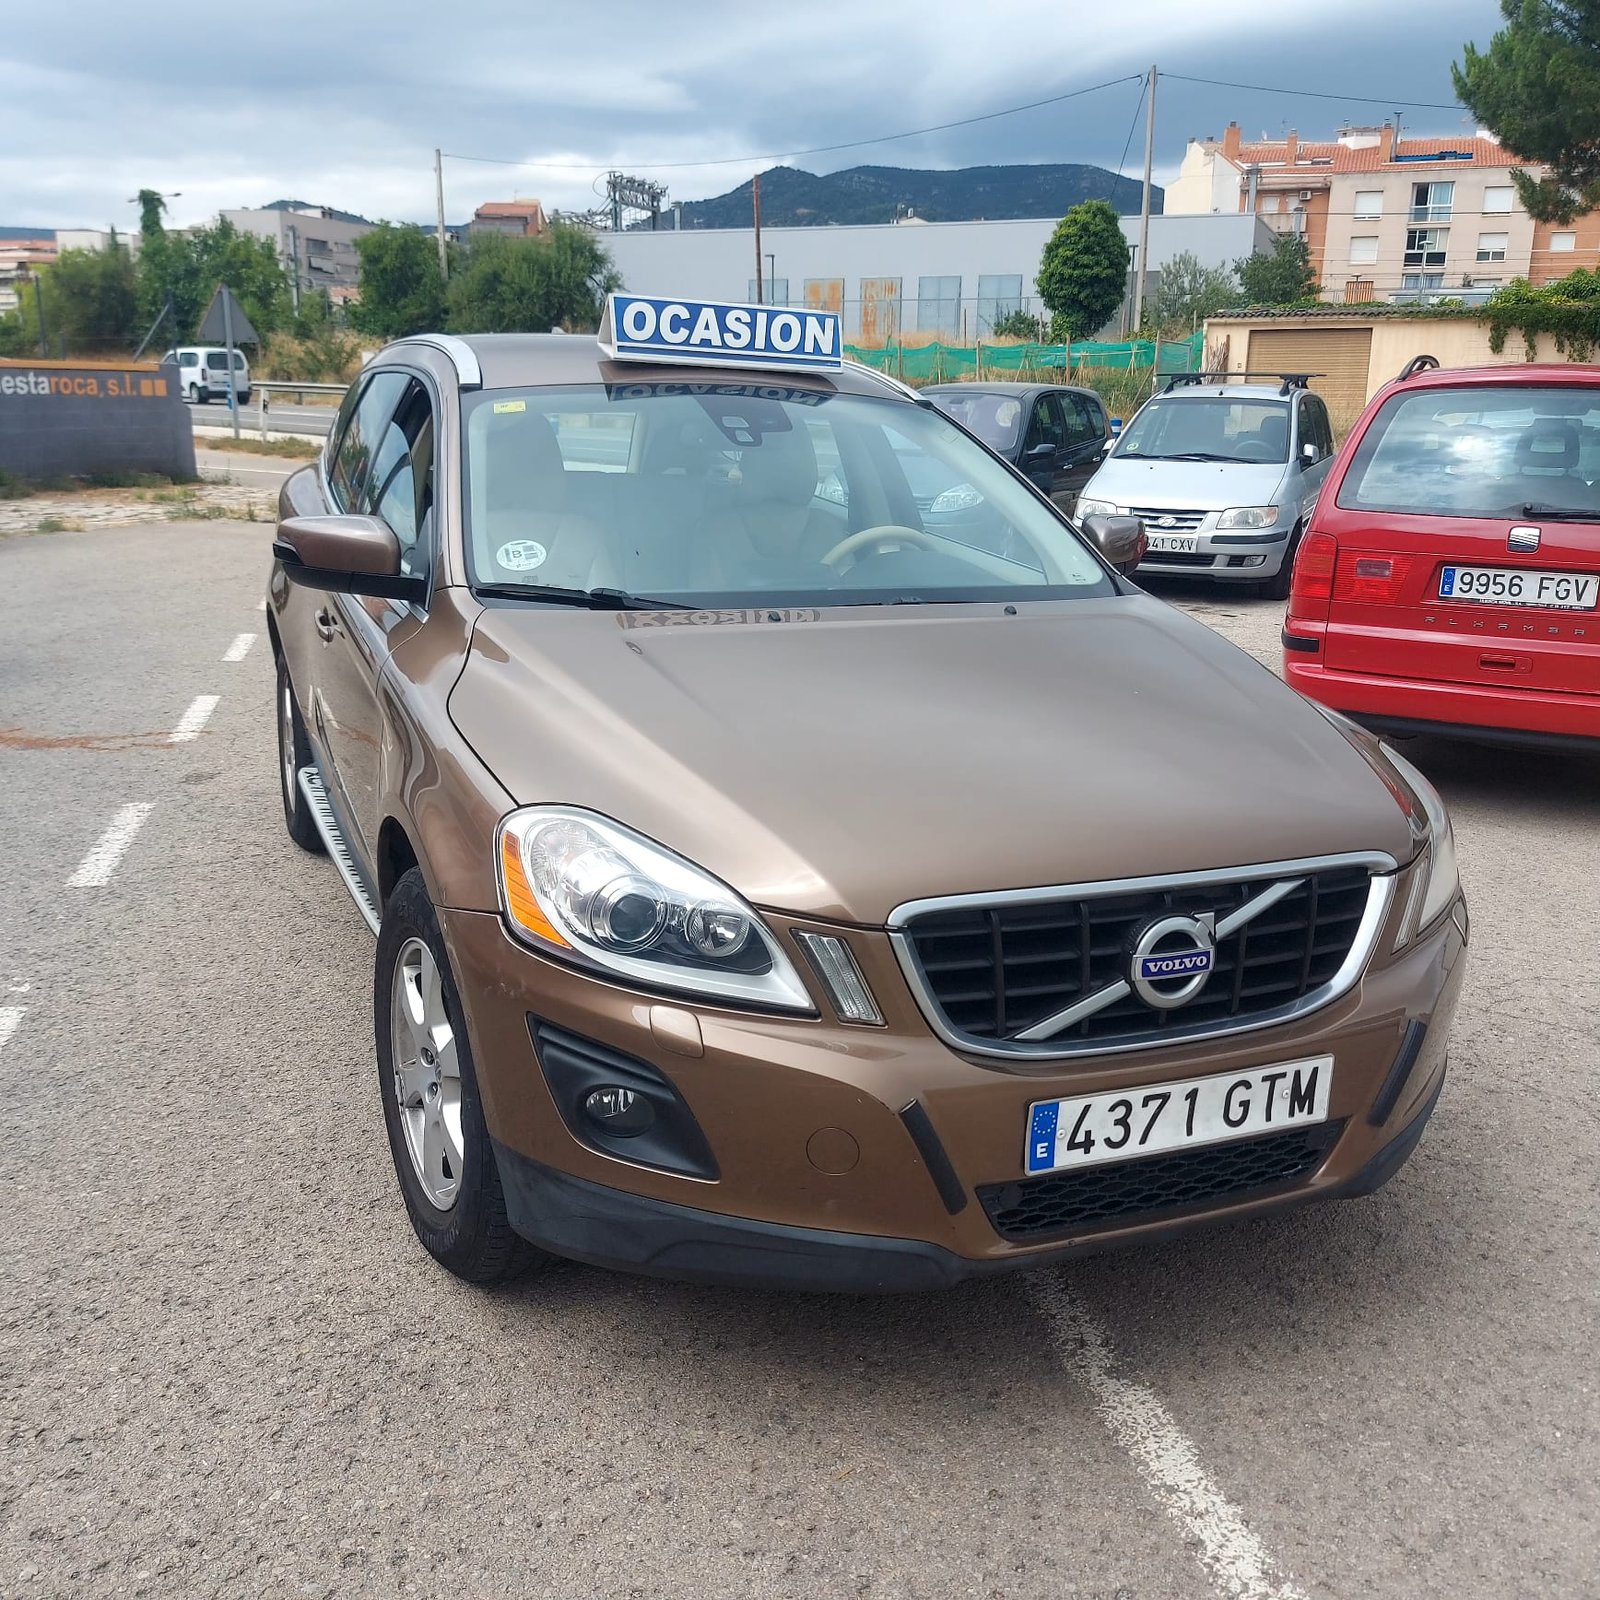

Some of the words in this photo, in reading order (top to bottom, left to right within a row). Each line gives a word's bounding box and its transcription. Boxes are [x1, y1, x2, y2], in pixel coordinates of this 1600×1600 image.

[622, 301, 834, 354] OCASION
[0, 372, 103, 397] estaroca,
[1147, 537, 1165, 550] 41
[1170, 538, 1194, 551] CXV
[1444, 584, 1451, 592] E
[1458, 571, 1524, 597] 9956
[1537, 577, 1590, 602] FGV
[1146, 956, 1207, 973] VOLVO
[1036, 1142, 1048, 1159] E
[1066, 1087, 1199, 1155] 4371
[1222, 1066, 1320, 1128] GTM
